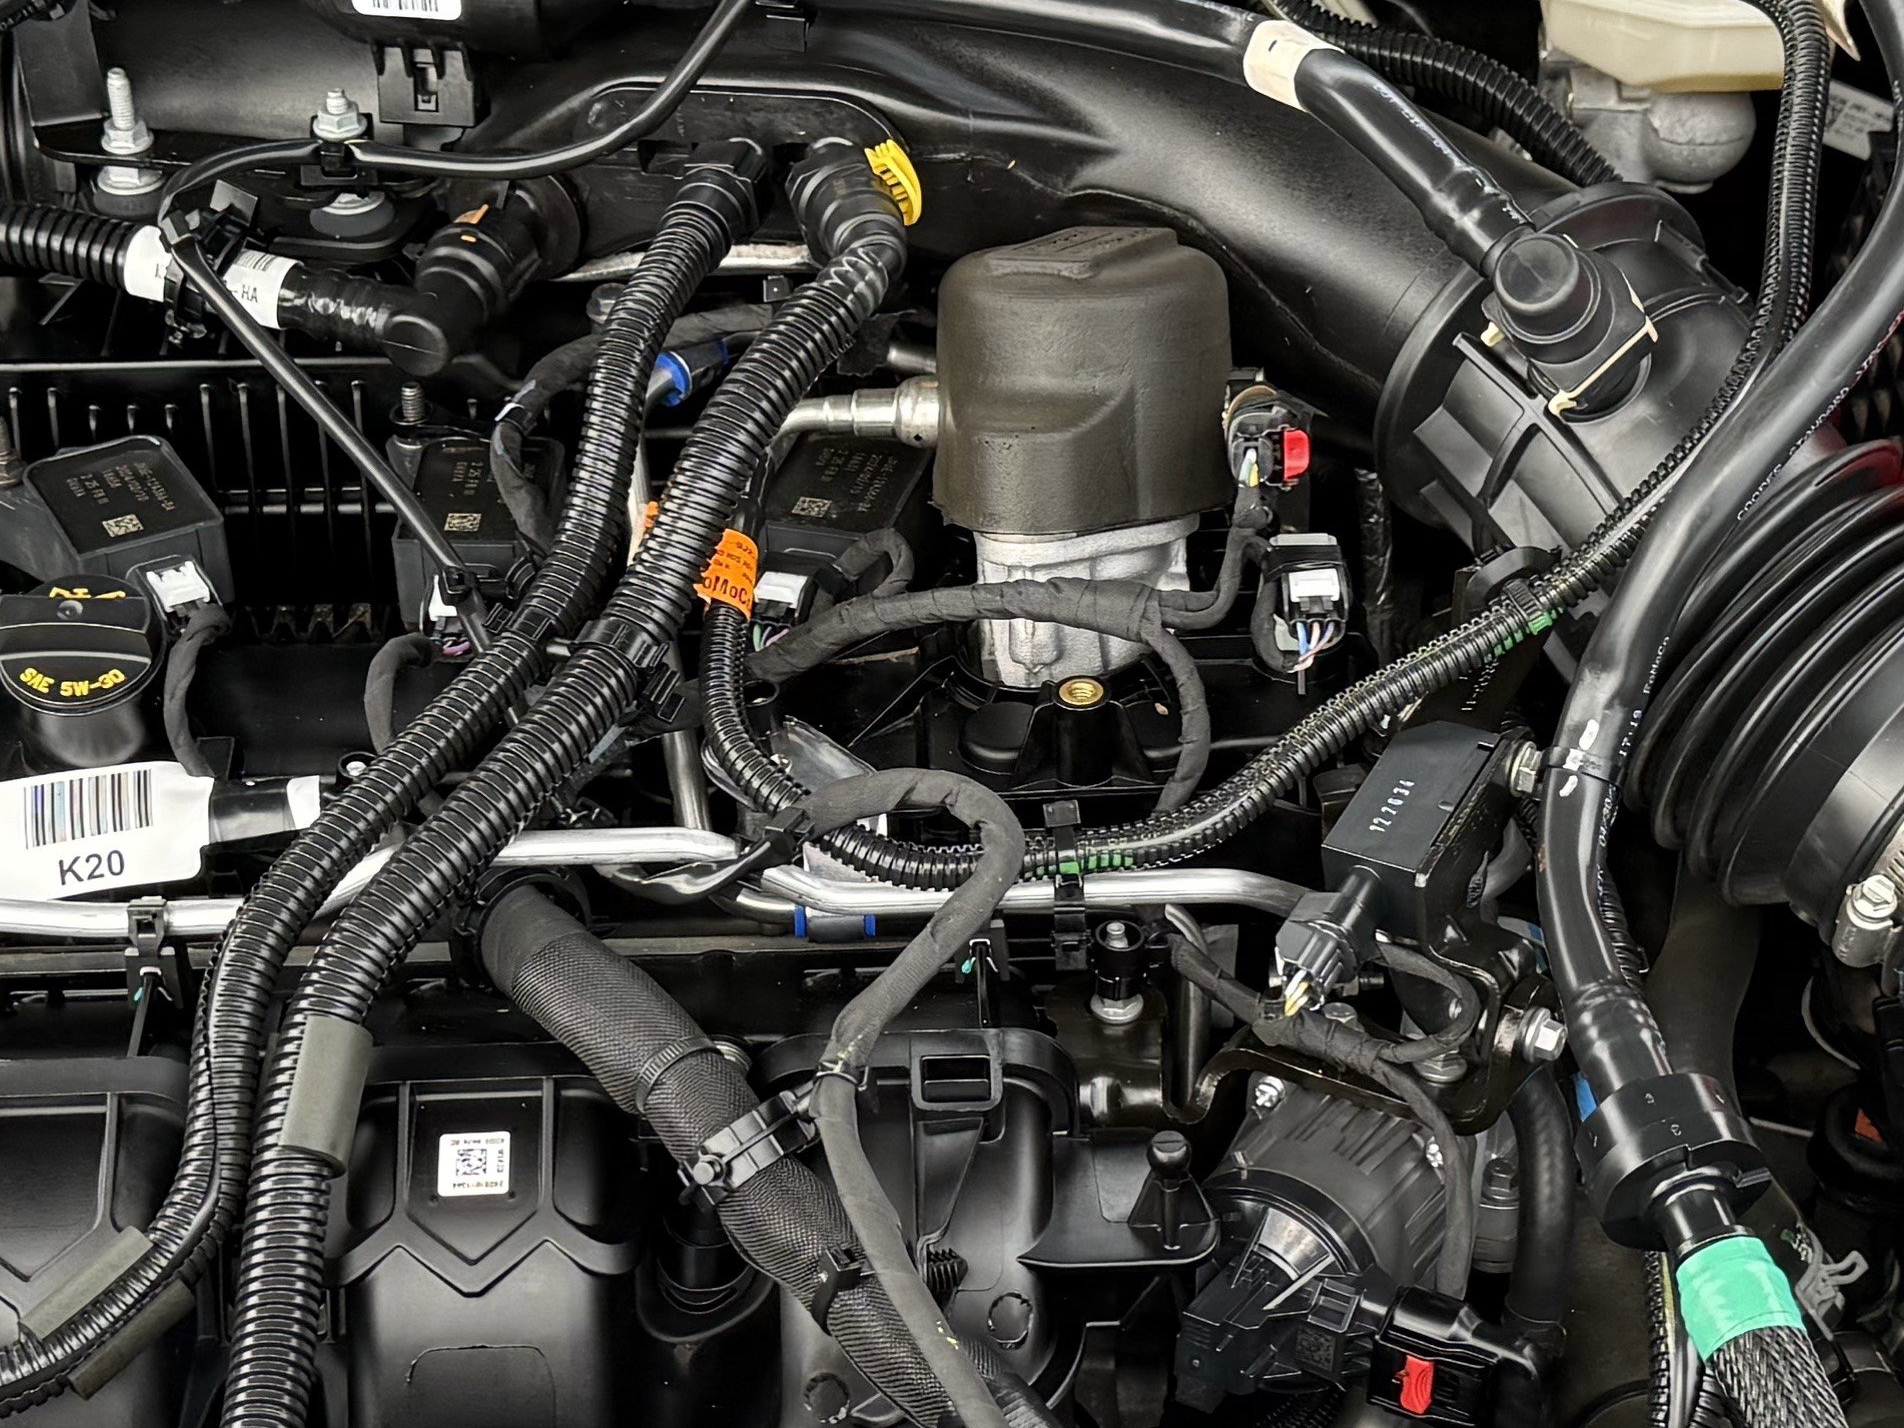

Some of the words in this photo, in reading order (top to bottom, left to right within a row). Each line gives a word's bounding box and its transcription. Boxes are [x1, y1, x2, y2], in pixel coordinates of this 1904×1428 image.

[19, 666, 52, 694] SAE
[60, 667, 126, 698] 5W-30
[58, 849, 125, 886] K20
